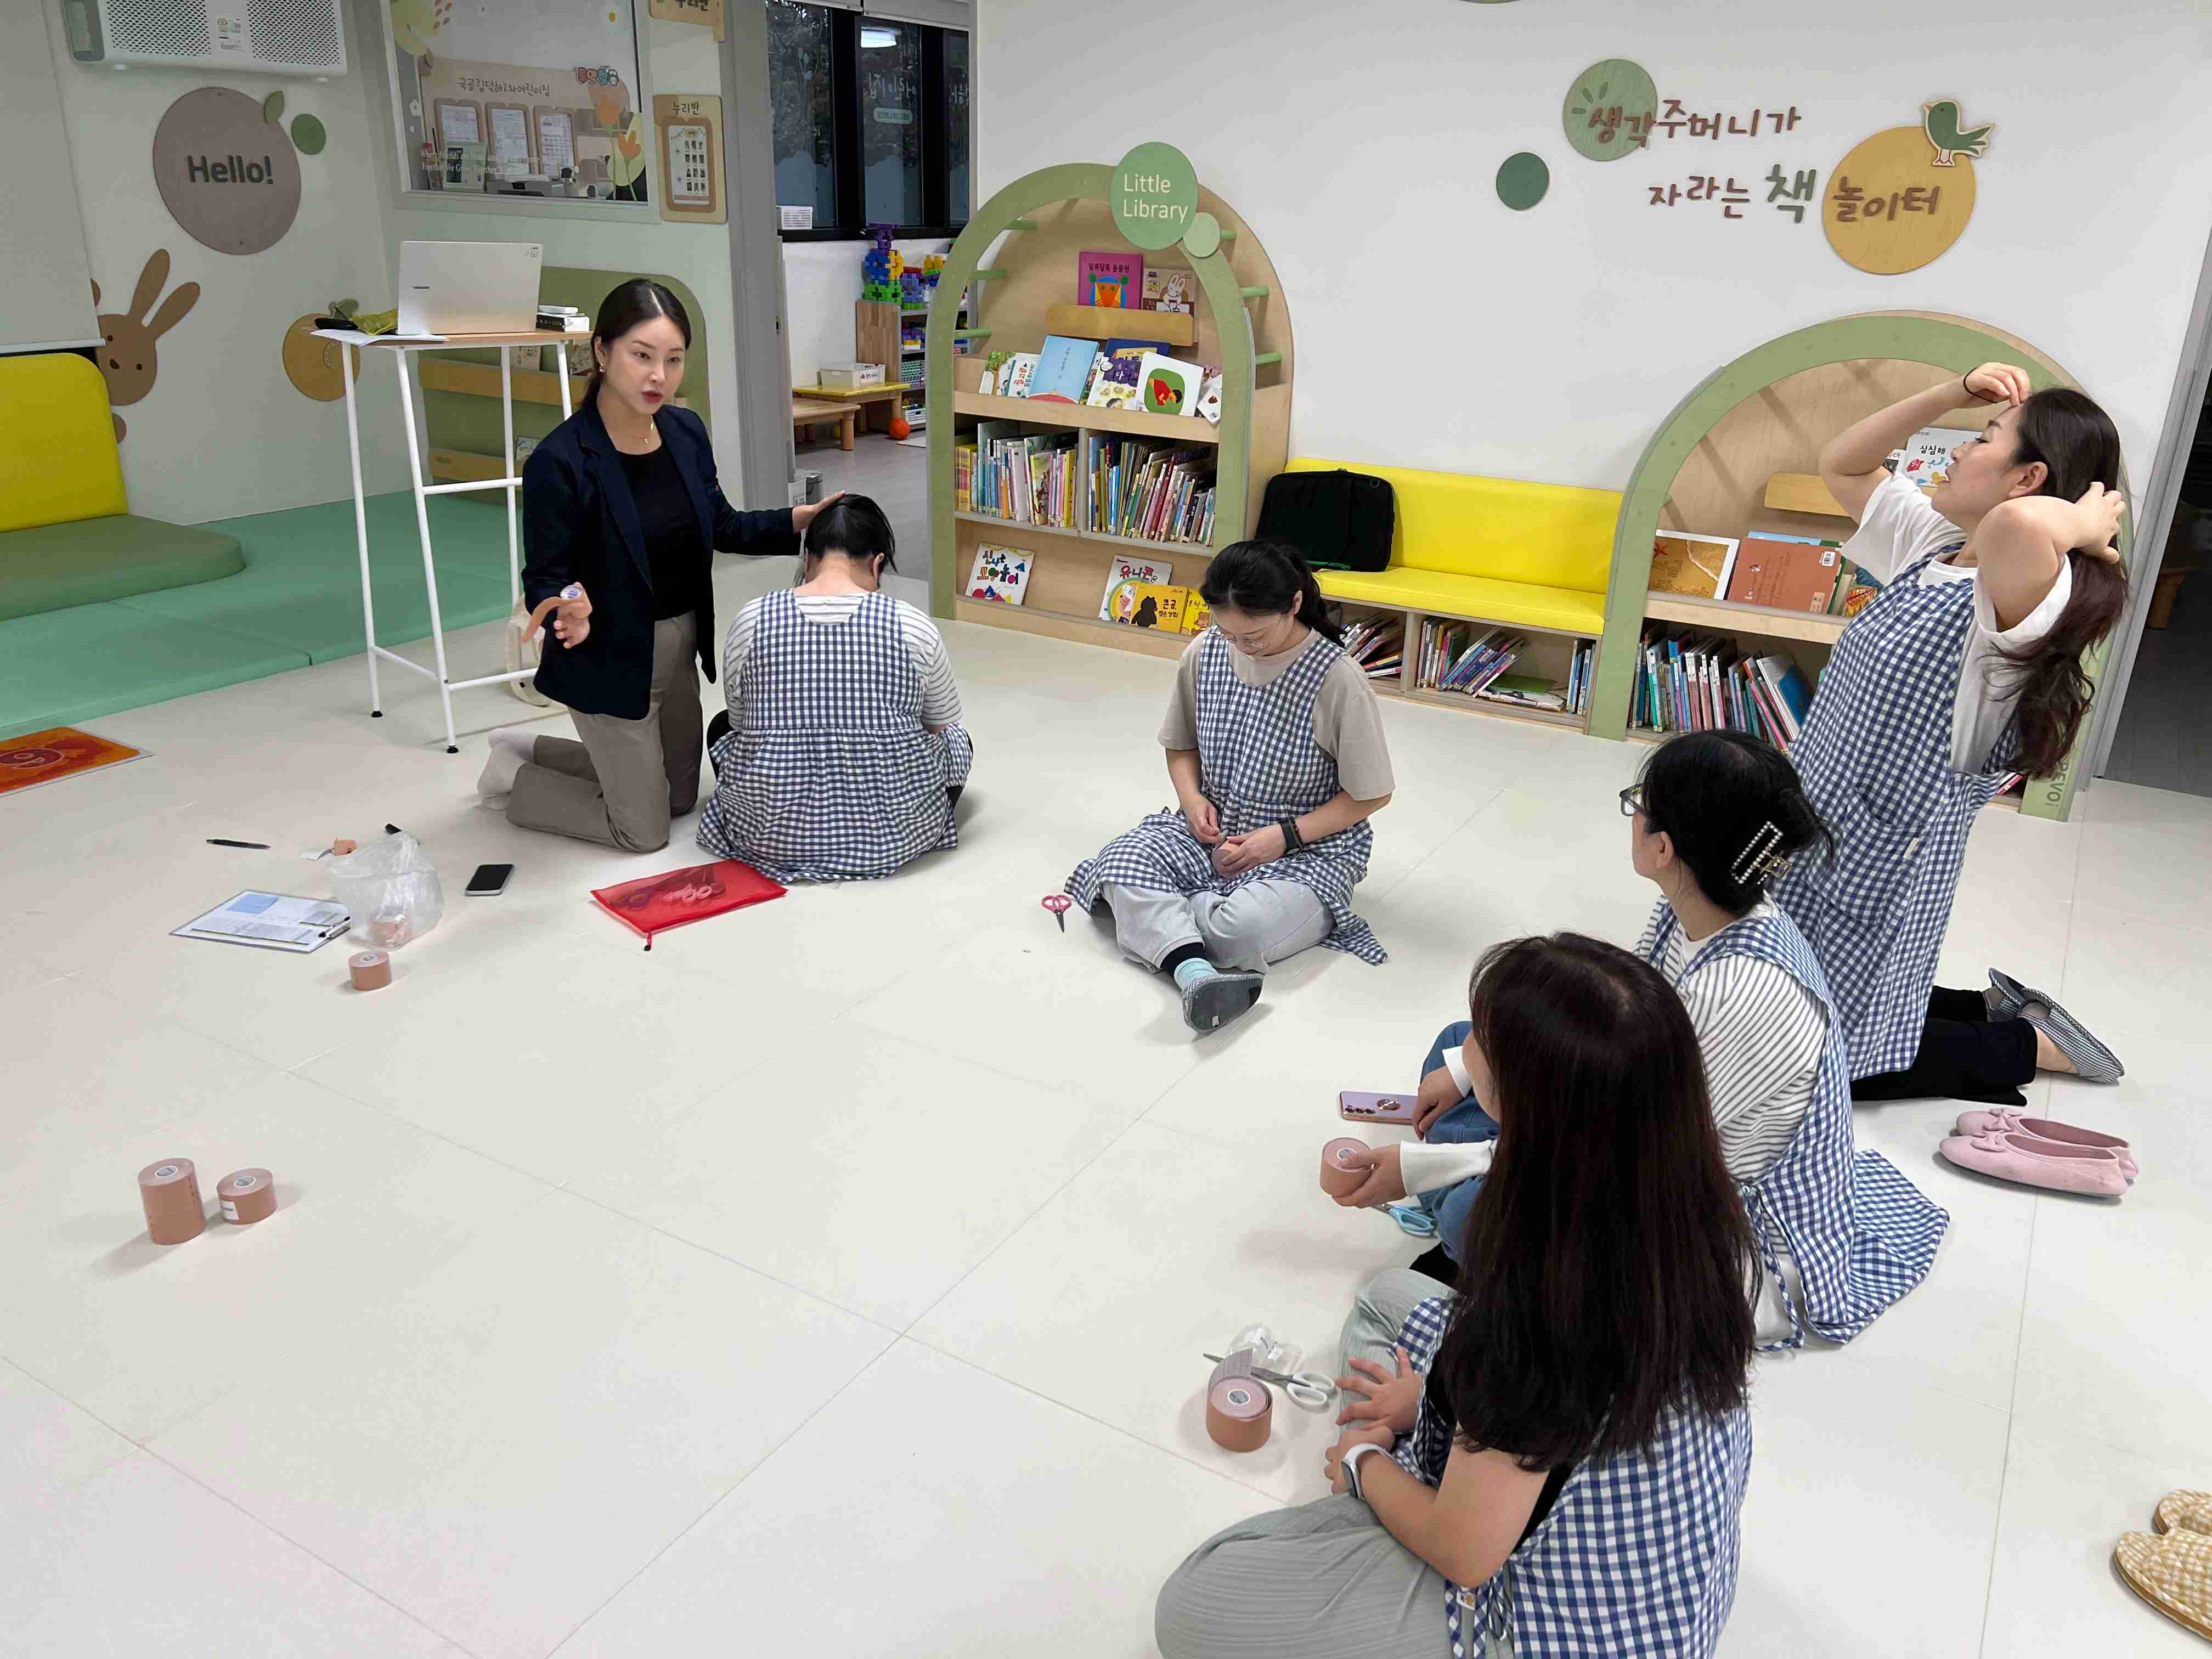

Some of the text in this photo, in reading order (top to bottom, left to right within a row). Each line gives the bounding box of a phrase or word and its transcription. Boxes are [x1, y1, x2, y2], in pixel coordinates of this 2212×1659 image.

[673, 101, 699, 115] 누리반
[187, 155, 274, 184] Hello!
[1124, 174, 1171, 194] Little
[1648, 164, 1940, 223] 자라는 책 놀이터
[1123, 199, 1188, 224] Library
